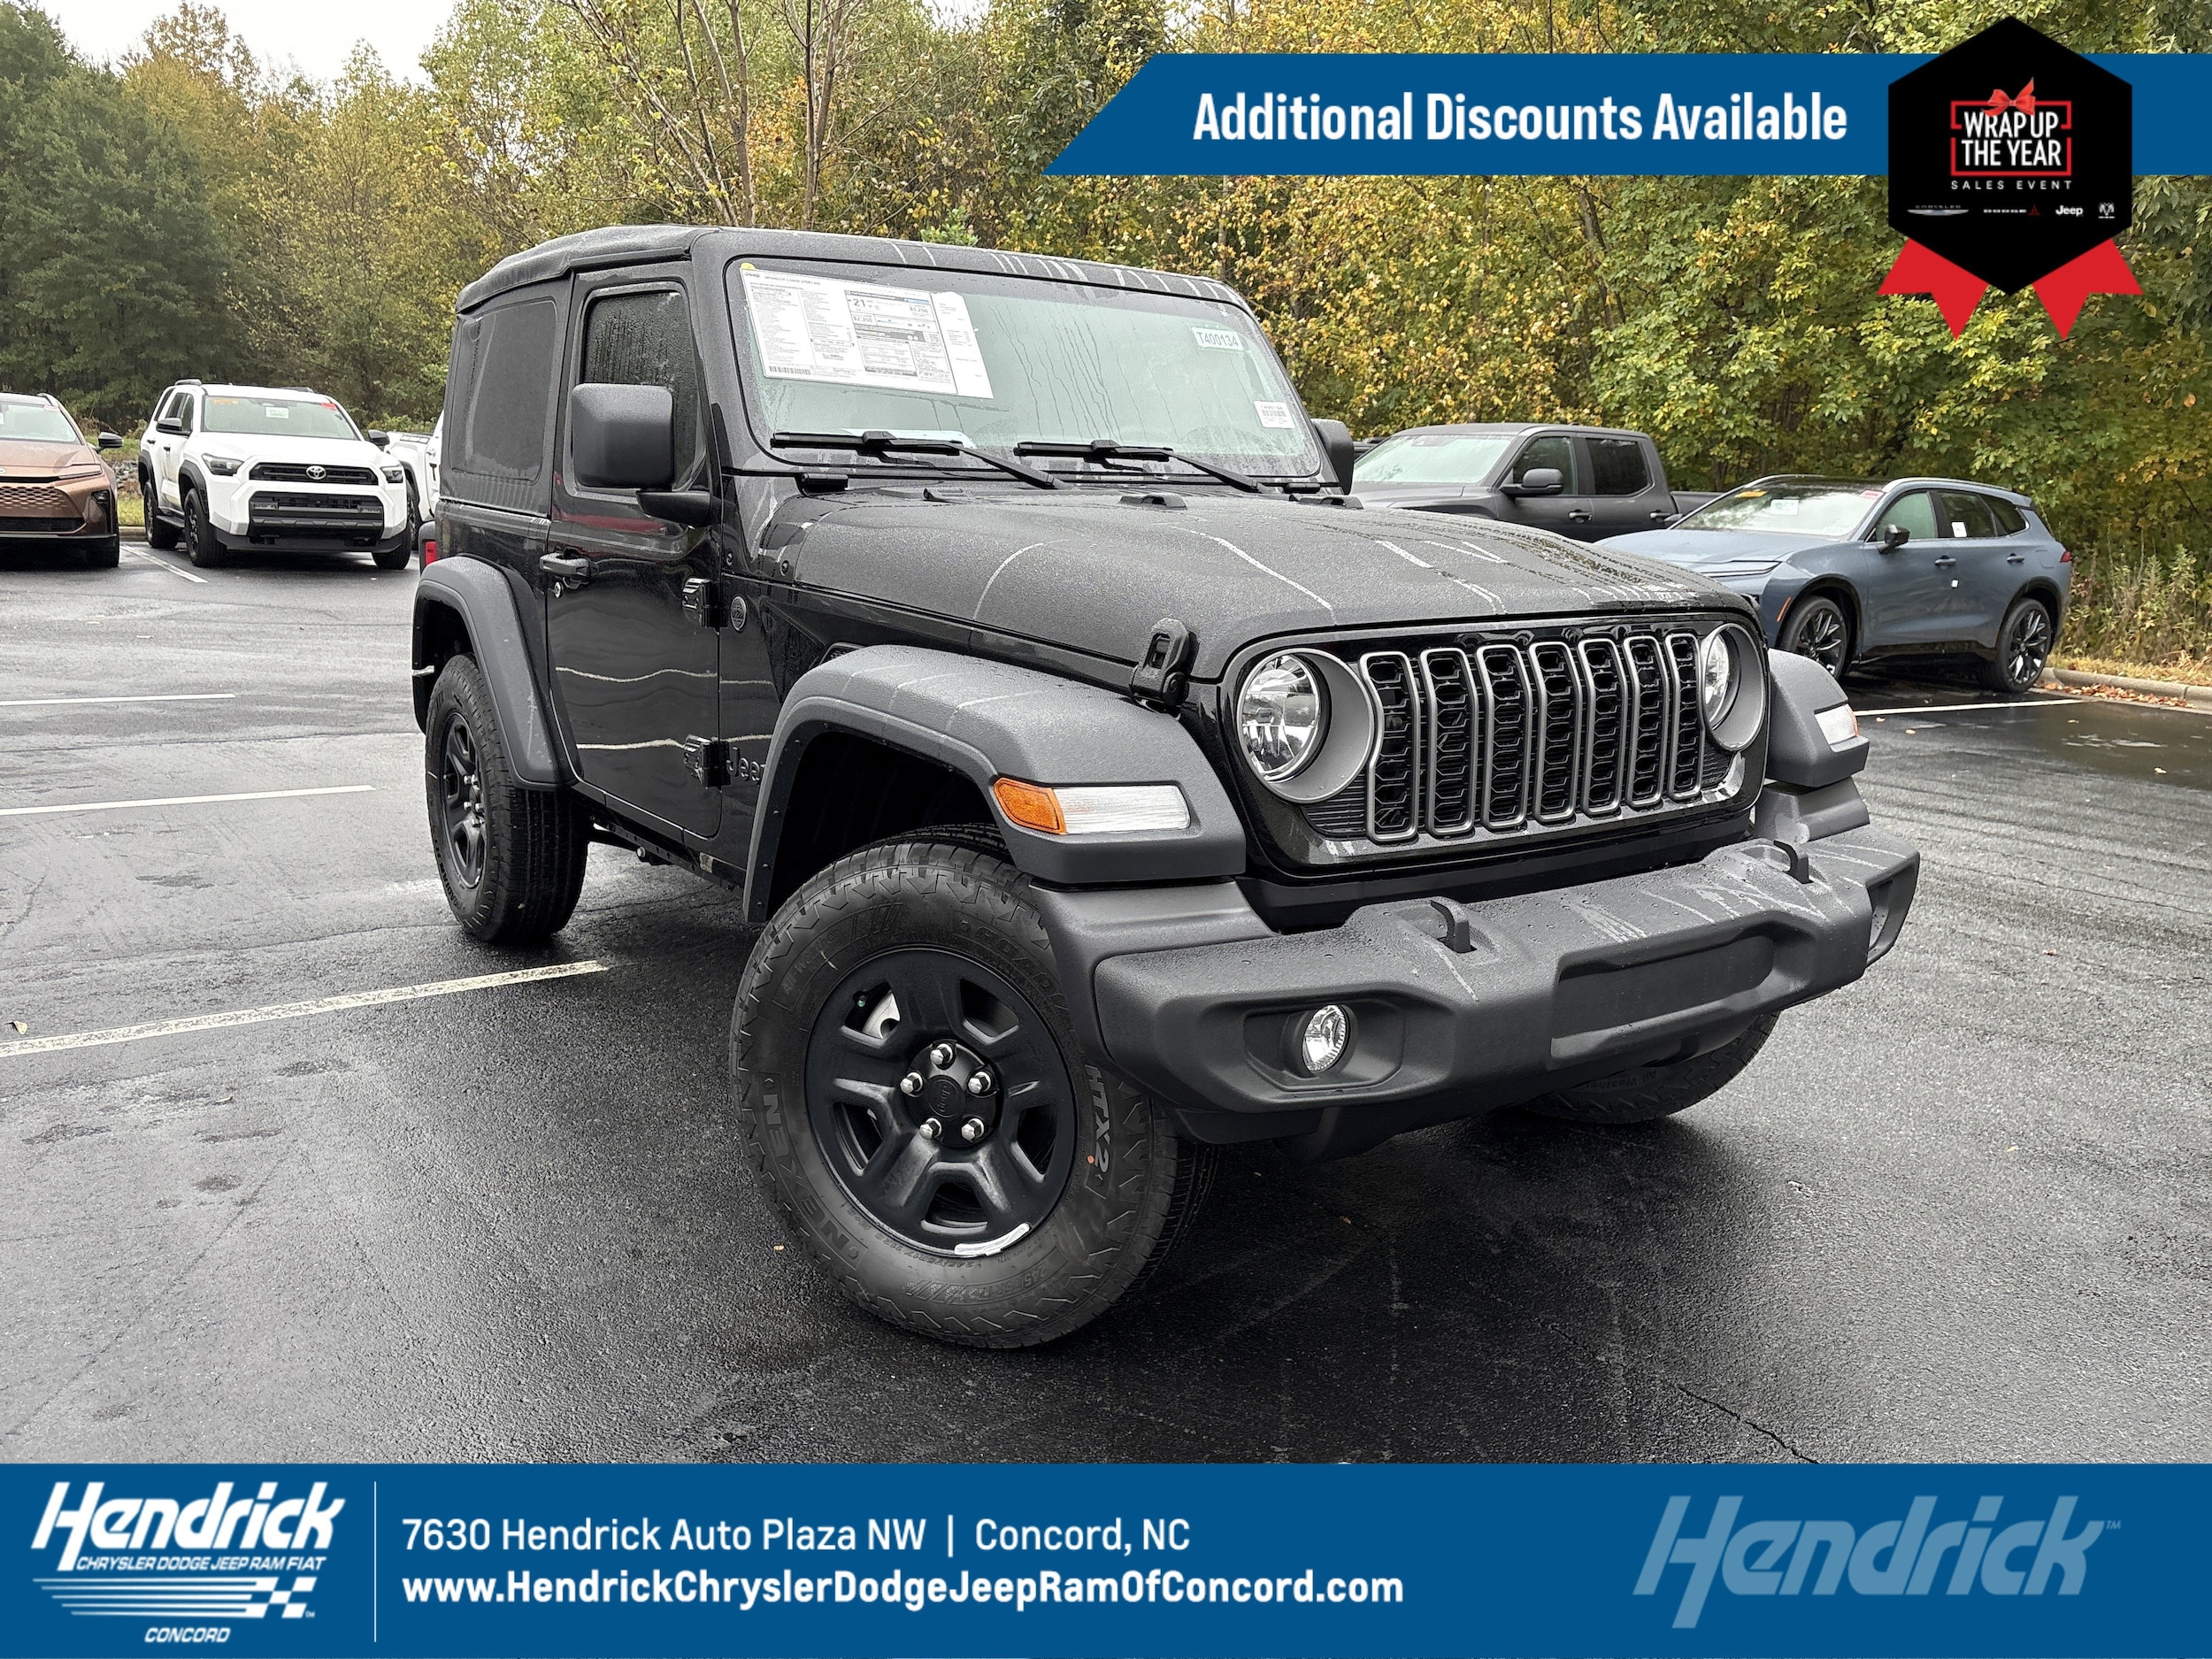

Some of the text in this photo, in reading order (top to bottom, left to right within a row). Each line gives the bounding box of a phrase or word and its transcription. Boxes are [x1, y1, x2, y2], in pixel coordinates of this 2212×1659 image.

[852, 298, 865, 307] 21
[1195, 331, 1239, 347] T400134
[726, 746, 765, 785] Jee
[1085, 1064, 1110, 1173] HTX2
[763, 1094, 850, 1249] NEXEN
